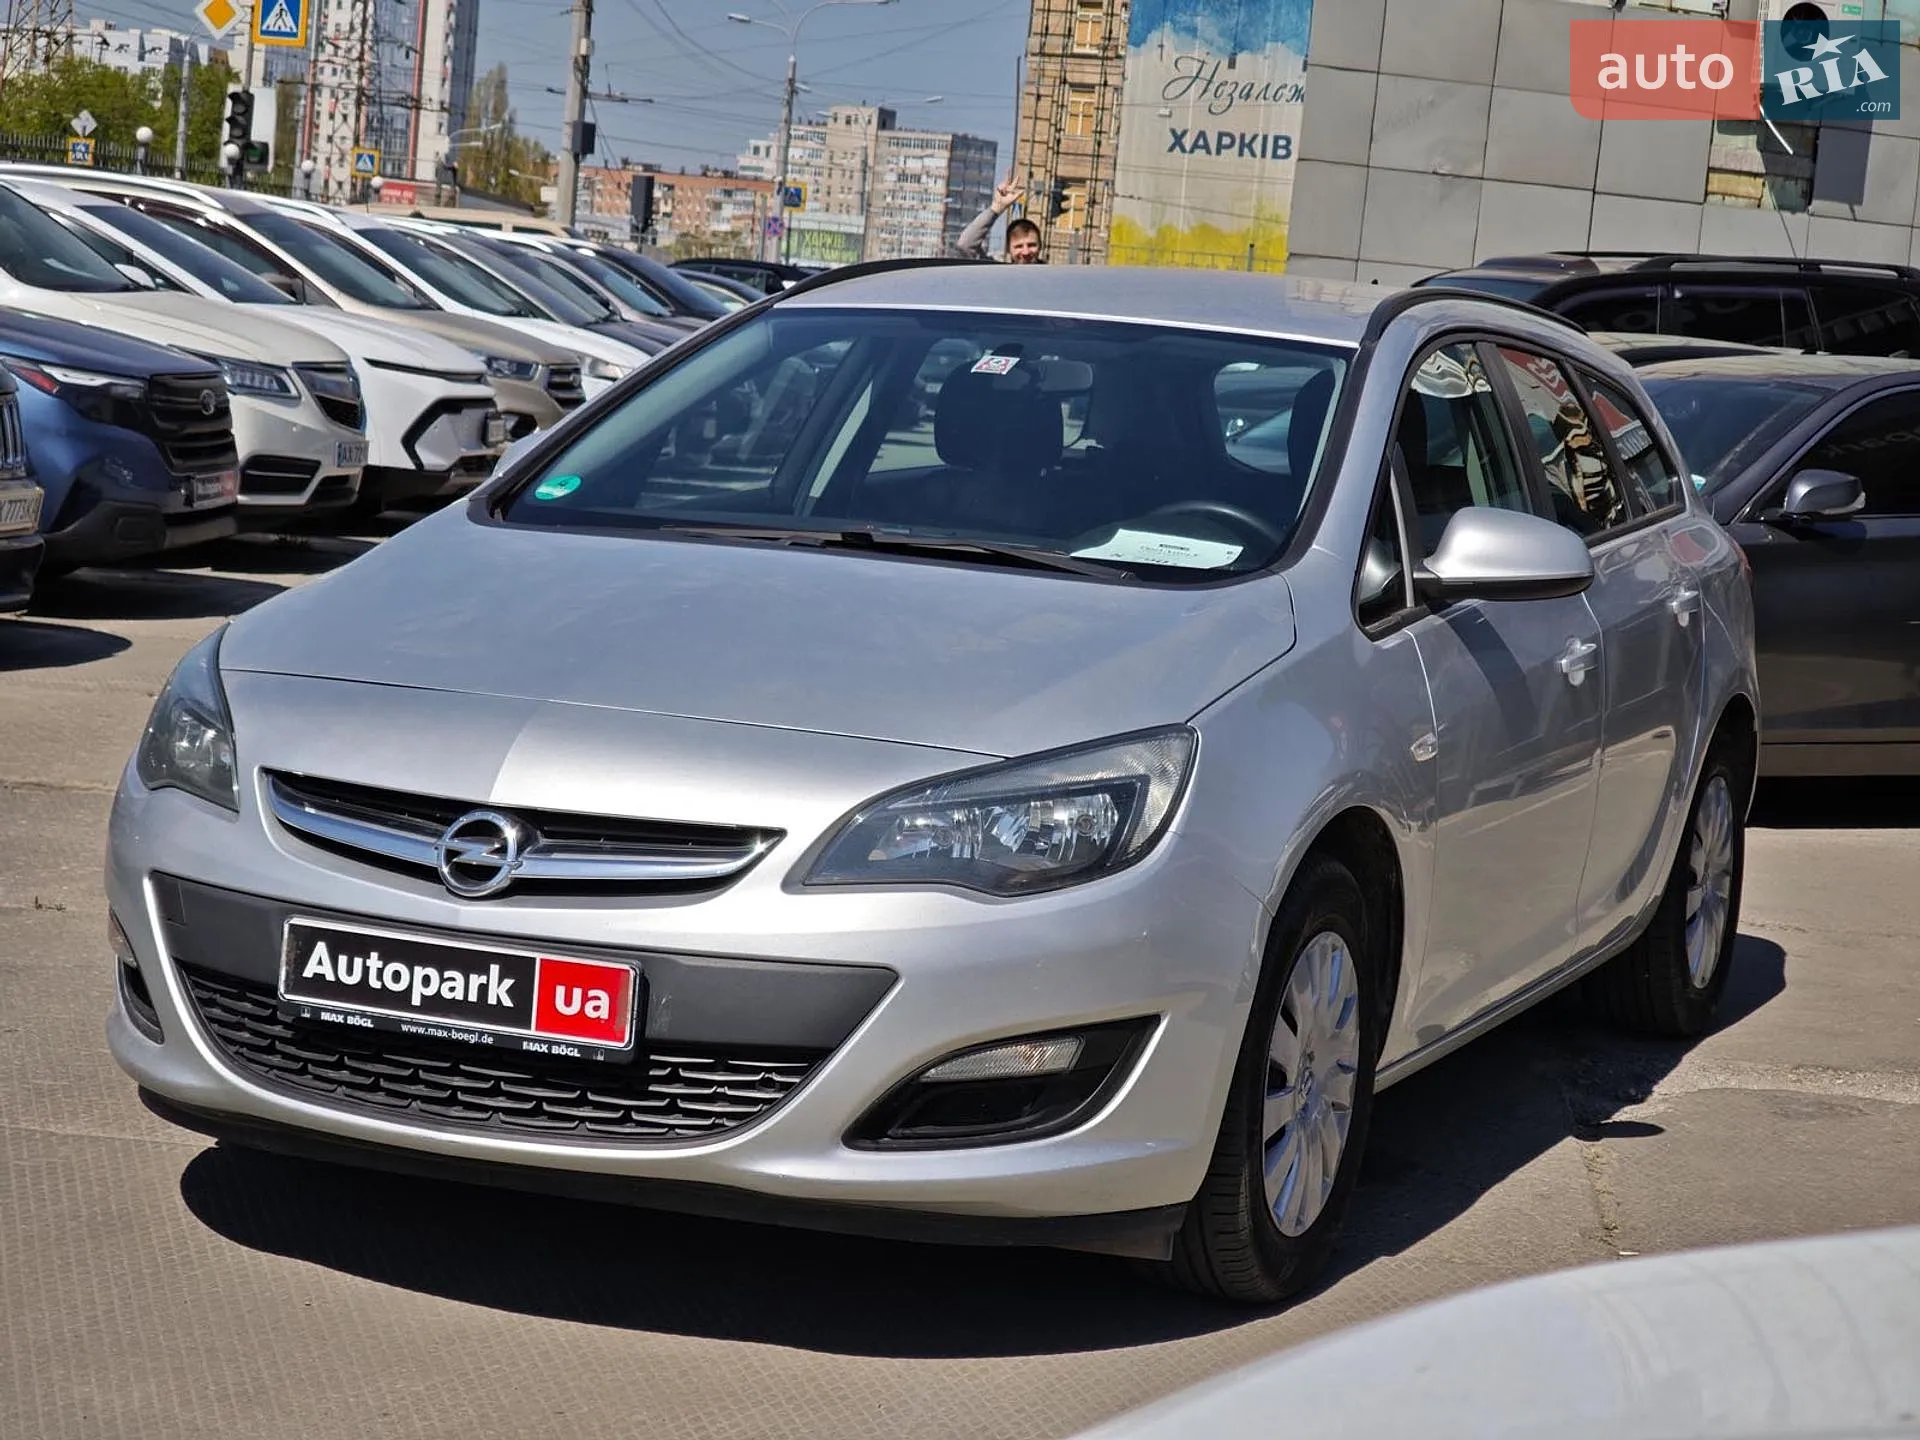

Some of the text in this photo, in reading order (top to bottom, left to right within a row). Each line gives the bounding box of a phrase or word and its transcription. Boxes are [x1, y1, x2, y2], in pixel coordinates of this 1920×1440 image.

[1167, 128, 1292, 160] ХАРКІВ
[302, 941, 610, 1020] Autopark ua
[320, 1011, 374, 1028] MAX BÖGL
[401, 1023, 494, 1045] www.max-boegl.de
[522, 1041, 581, 1058] MAX BÖGL
